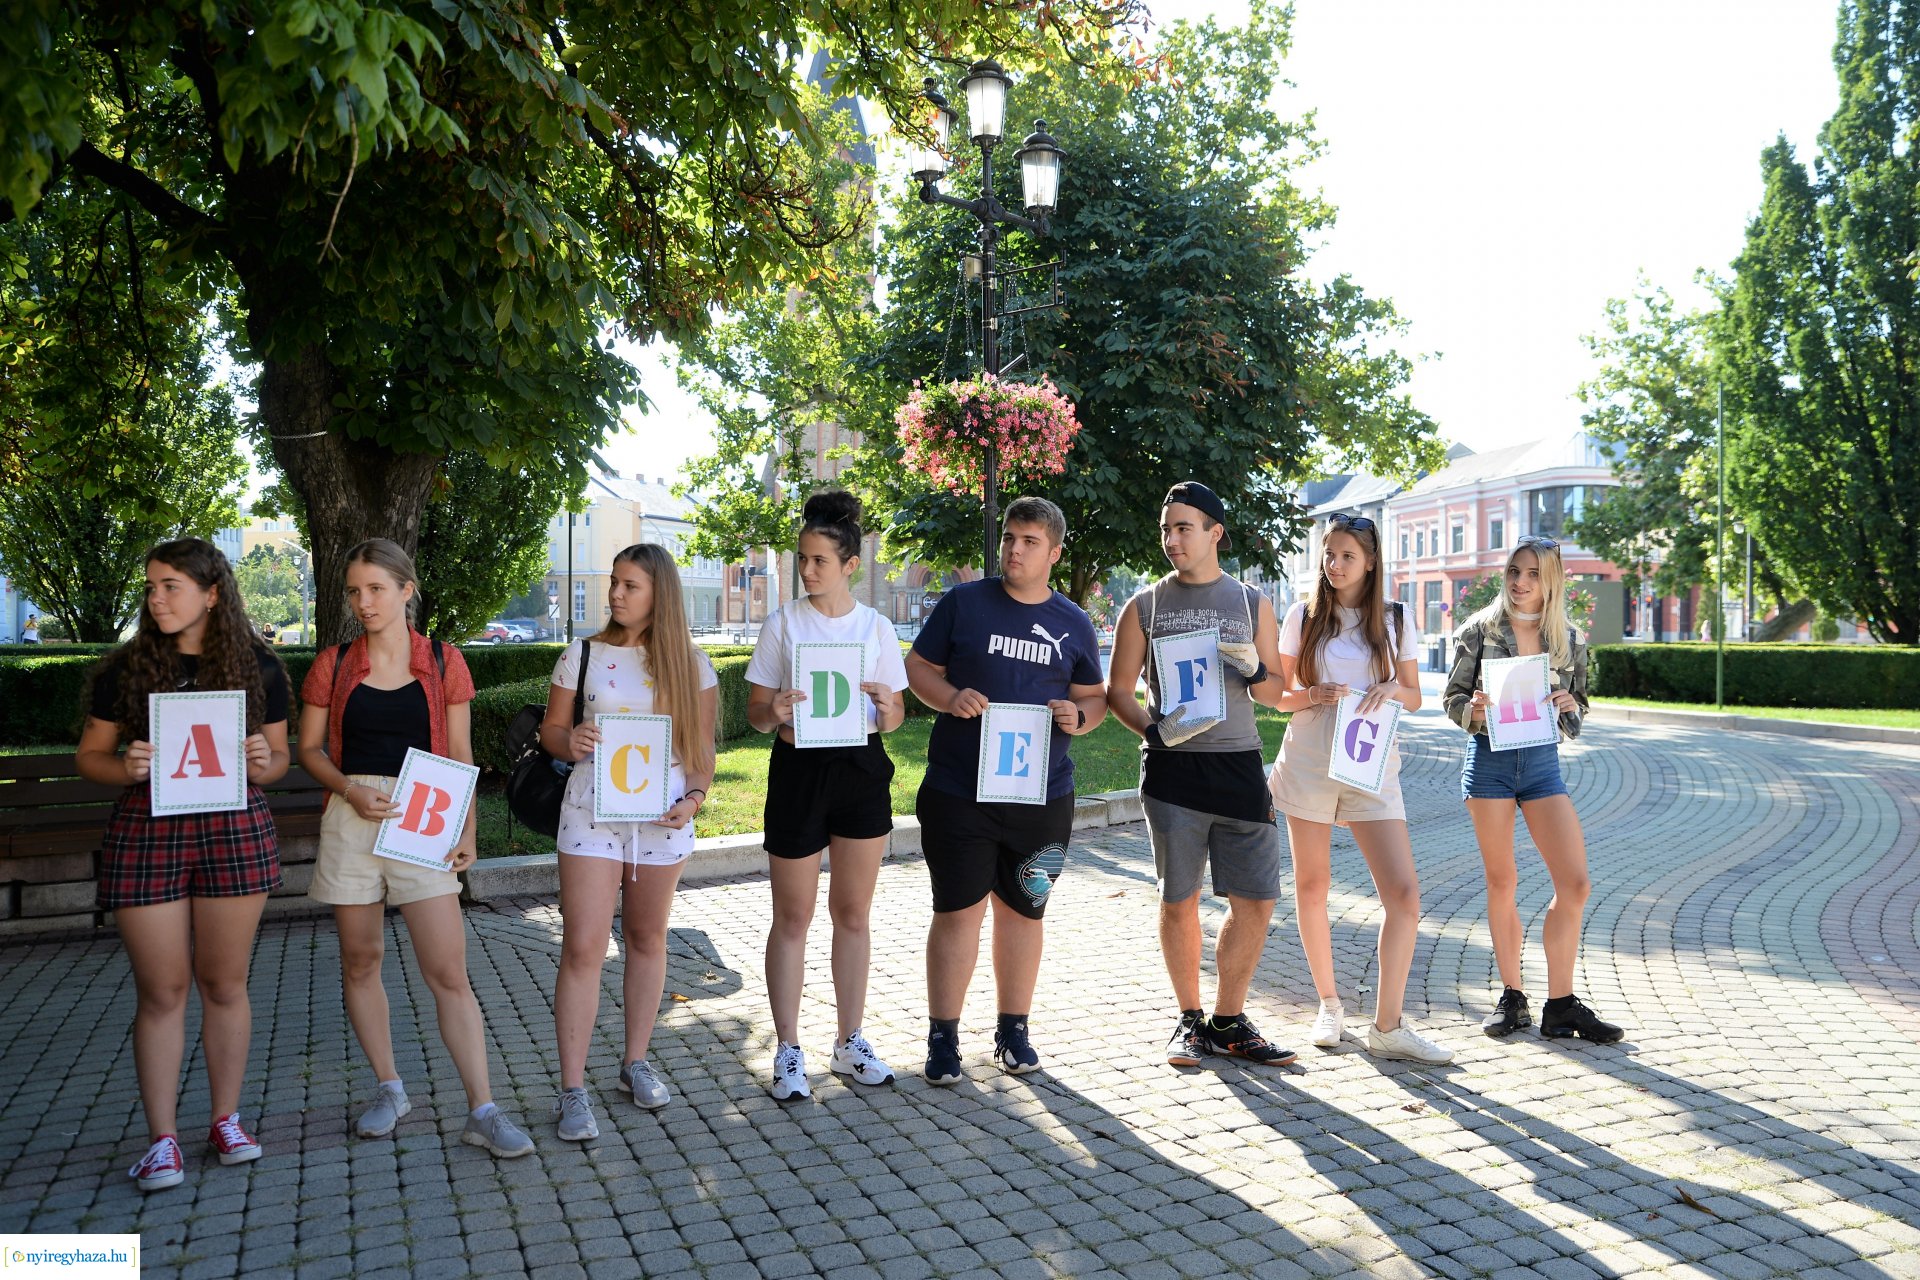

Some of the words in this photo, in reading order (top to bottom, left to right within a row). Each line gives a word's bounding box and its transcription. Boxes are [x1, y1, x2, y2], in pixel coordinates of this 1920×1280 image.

[988, 633, 1052, 665] PUMA
[810, 670, 850, 718] D
[1174, 657, 1207, 704] F
[171, 724, 225, 779] A
[995, 731, 1032, 778] E
[1345, 718, 1378, 763] G
[610, 744, 650, 794] C
[399, 783, 451, 836] B
